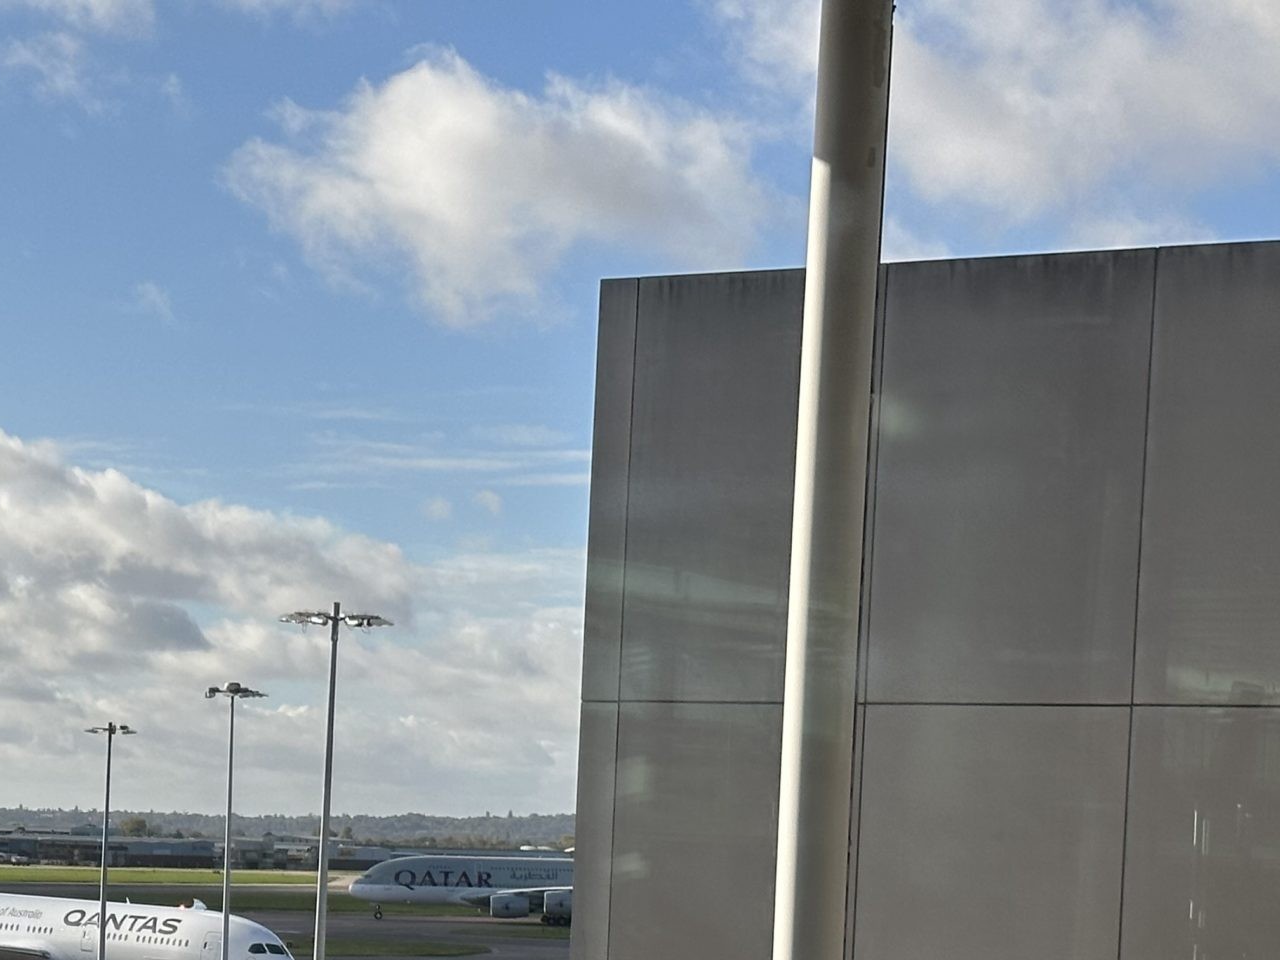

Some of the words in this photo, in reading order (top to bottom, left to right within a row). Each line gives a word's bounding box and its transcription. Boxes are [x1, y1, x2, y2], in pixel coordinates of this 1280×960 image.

[394, 869, 493, 891] QATAR
[8, 908, 43, 919] Australia
[63, 909, 183, 935] QANTAS
